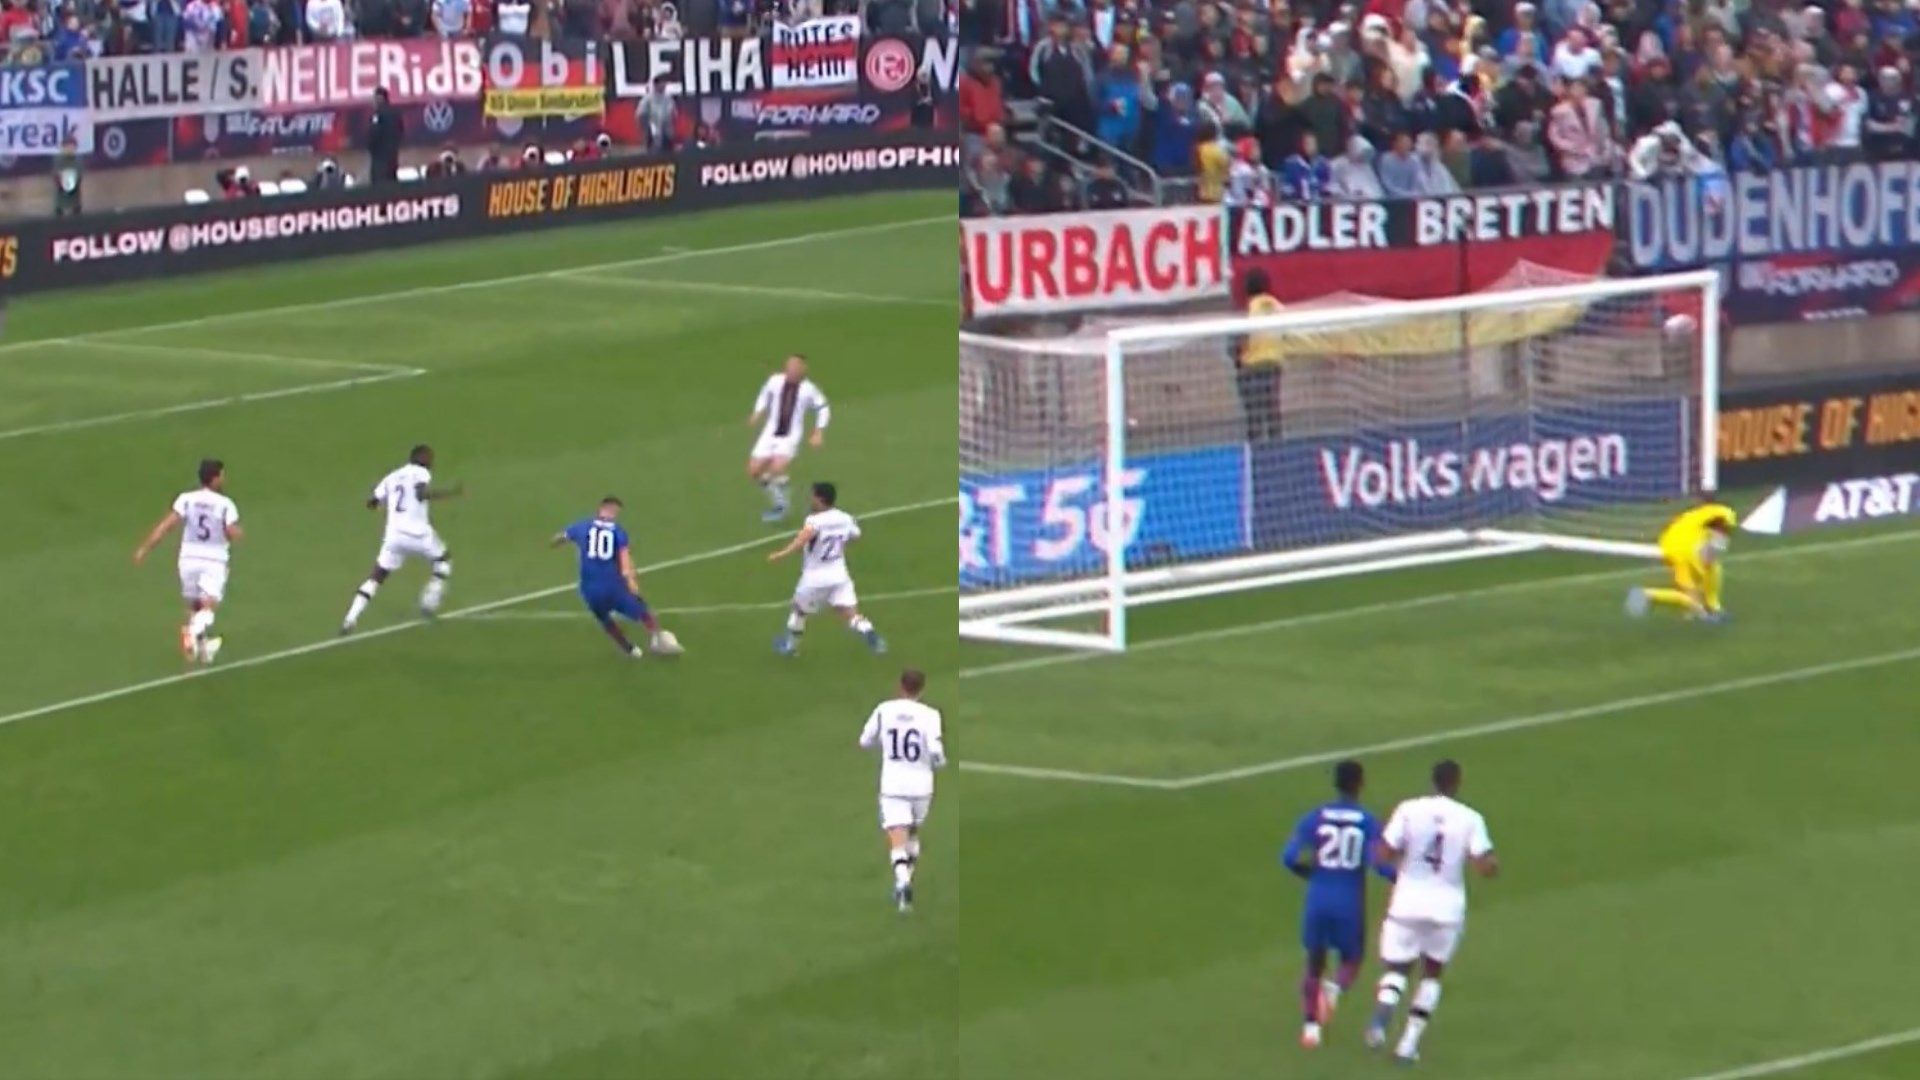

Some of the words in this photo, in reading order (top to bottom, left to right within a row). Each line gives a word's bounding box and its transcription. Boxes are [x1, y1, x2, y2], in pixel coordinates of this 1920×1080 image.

[1, 69, 70, 104] KSC
[92, 60, 200, 109] HALLE
[612, 37, 765, 97] LEIHA
[0, 113, 78, 149] reak
[488, 178, 549, 218] HOUSE
[552, 174, 576, 211] OF
[577, 164, 676, 207] HIGHLIGHTS
[701, 158, 788, 187] FOLLOW
[52, 228, 165, 263] FOLLOW
[168, 194, 460, 252] @HOUSEOFHIGHLIGHTS
[1238, 202, 1389, 255] ADLER
[1416, 184, 1615, 246] BRETTEN
[974, 215, 1221, 305] URBACH
[1819, 397, 1864, 450] OF
[394, 484, 407, 513] 2
[1814, 472, 1920, 523] AT&T
[198, 514, 211, 542] 5
[587, 526, 615, 561] 10
[886, 727, 922, 763] 16
[1316, 823, 1365, 870] 20
[1424, 831, 1444, 874] 4
